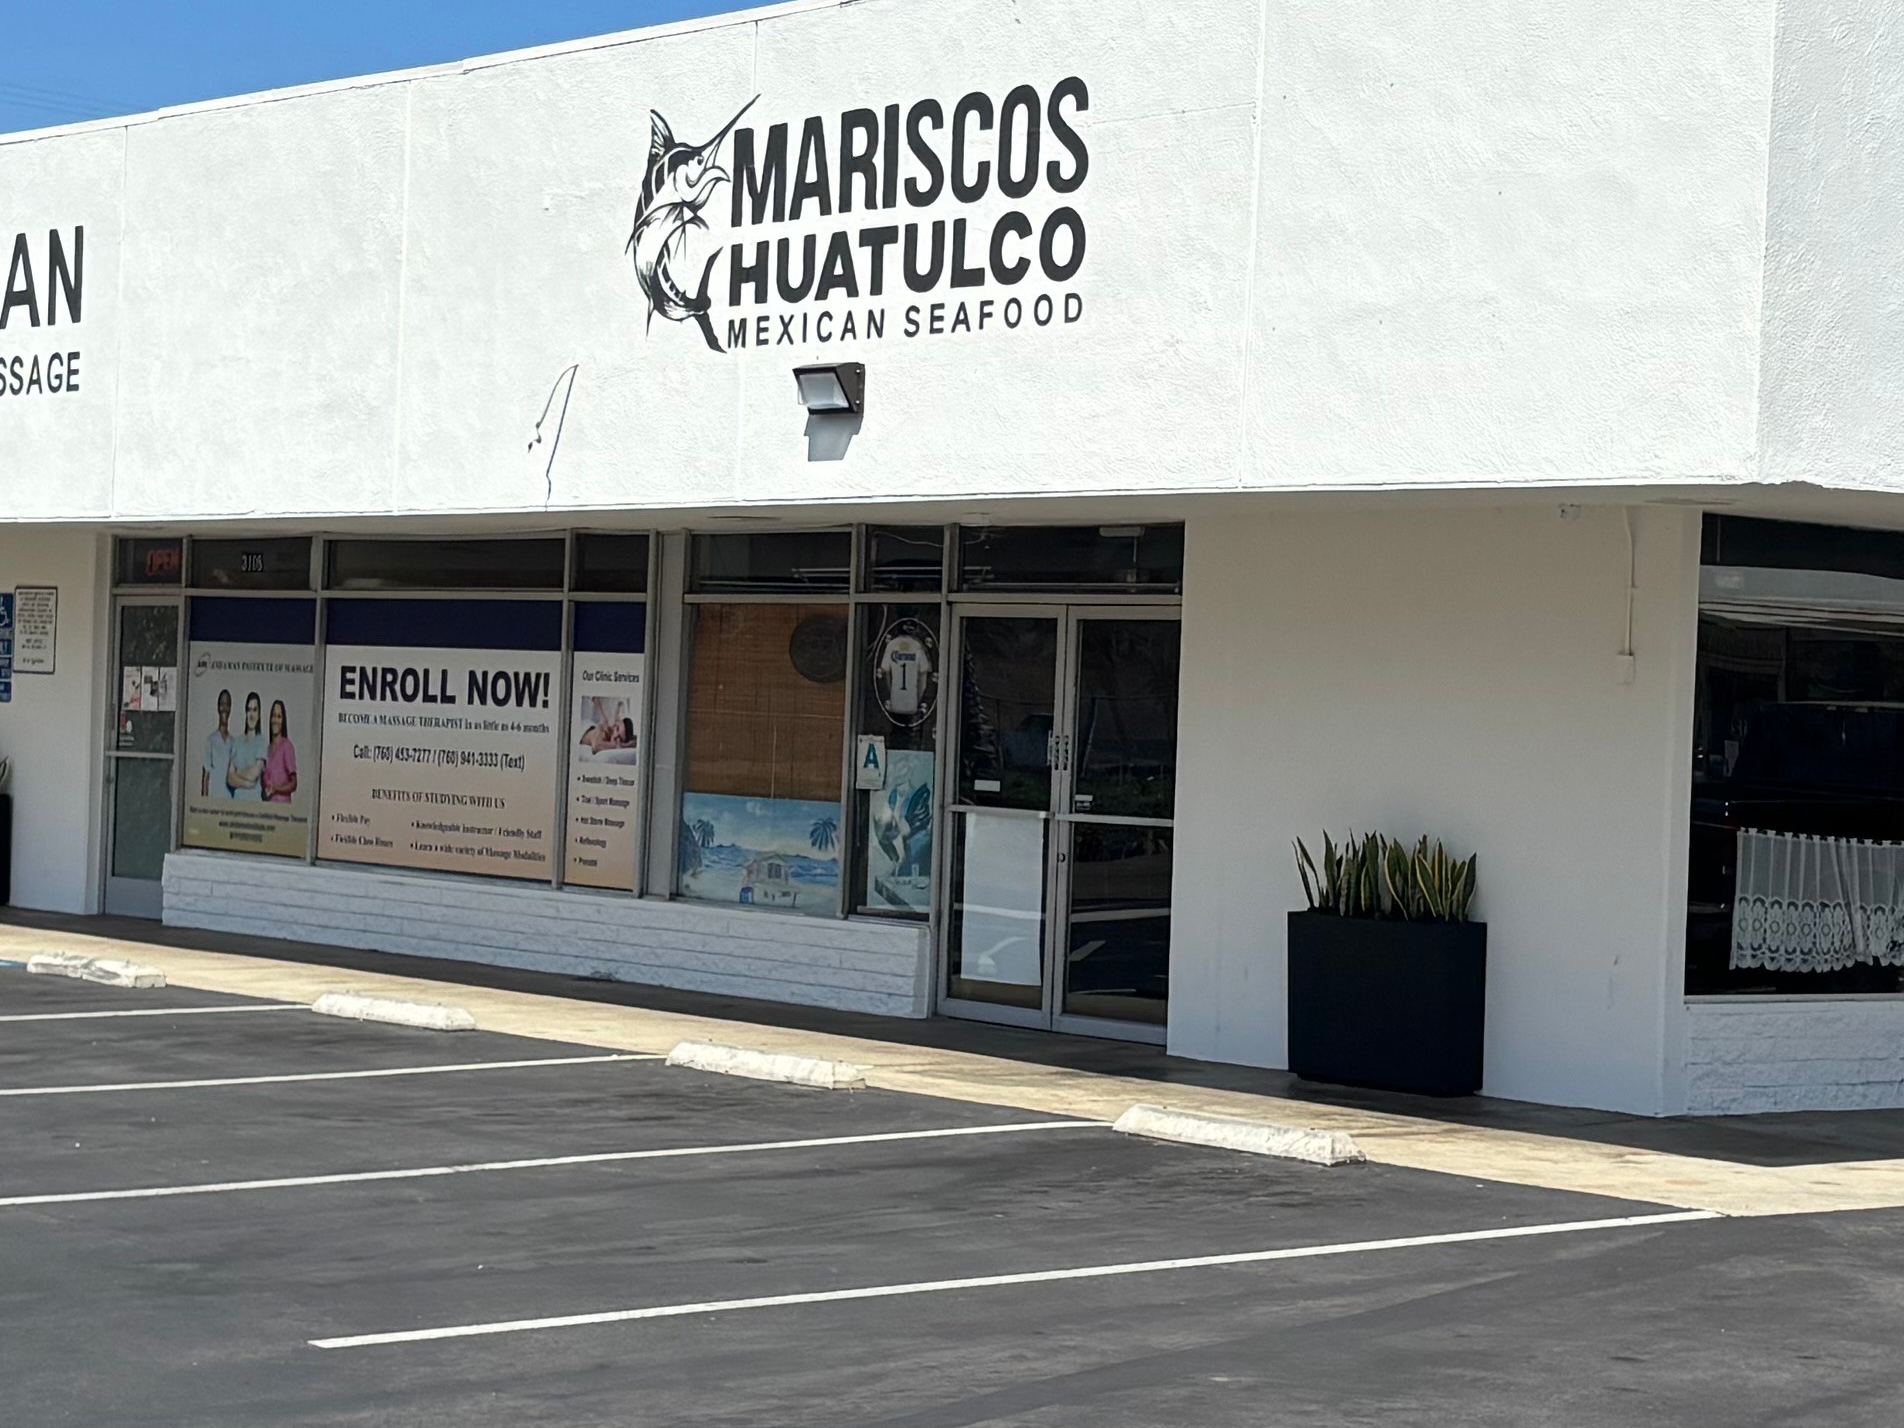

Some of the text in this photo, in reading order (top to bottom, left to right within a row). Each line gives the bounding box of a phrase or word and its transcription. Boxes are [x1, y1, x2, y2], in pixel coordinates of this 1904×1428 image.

[731, 76, 1089, 227] MARISCOS
[729, 206, 1086, 308] HUATULCO
[726, 292, 1083, 349] MEXICAN SEAFOOD
[340, 665, 550, 708] ENROLL NOW!
[899, 663, 907, 690] 1
[338, 712, 370, 725] BECOME
[379, 714, 417, 727] MASSAGE
[419, 715, 463, 730] THERAPIST
[353, 745, 372, 760] Call:
[460, 750, 498, 767] 941-3333
[500, 753, 525, 771] (Text)
[863, 743, 880, 768] A
[371, 788, 410, 802] BENEFITS
[412, 790, 424, 803] OF
[425, 792, 467, 806] STUDYING
